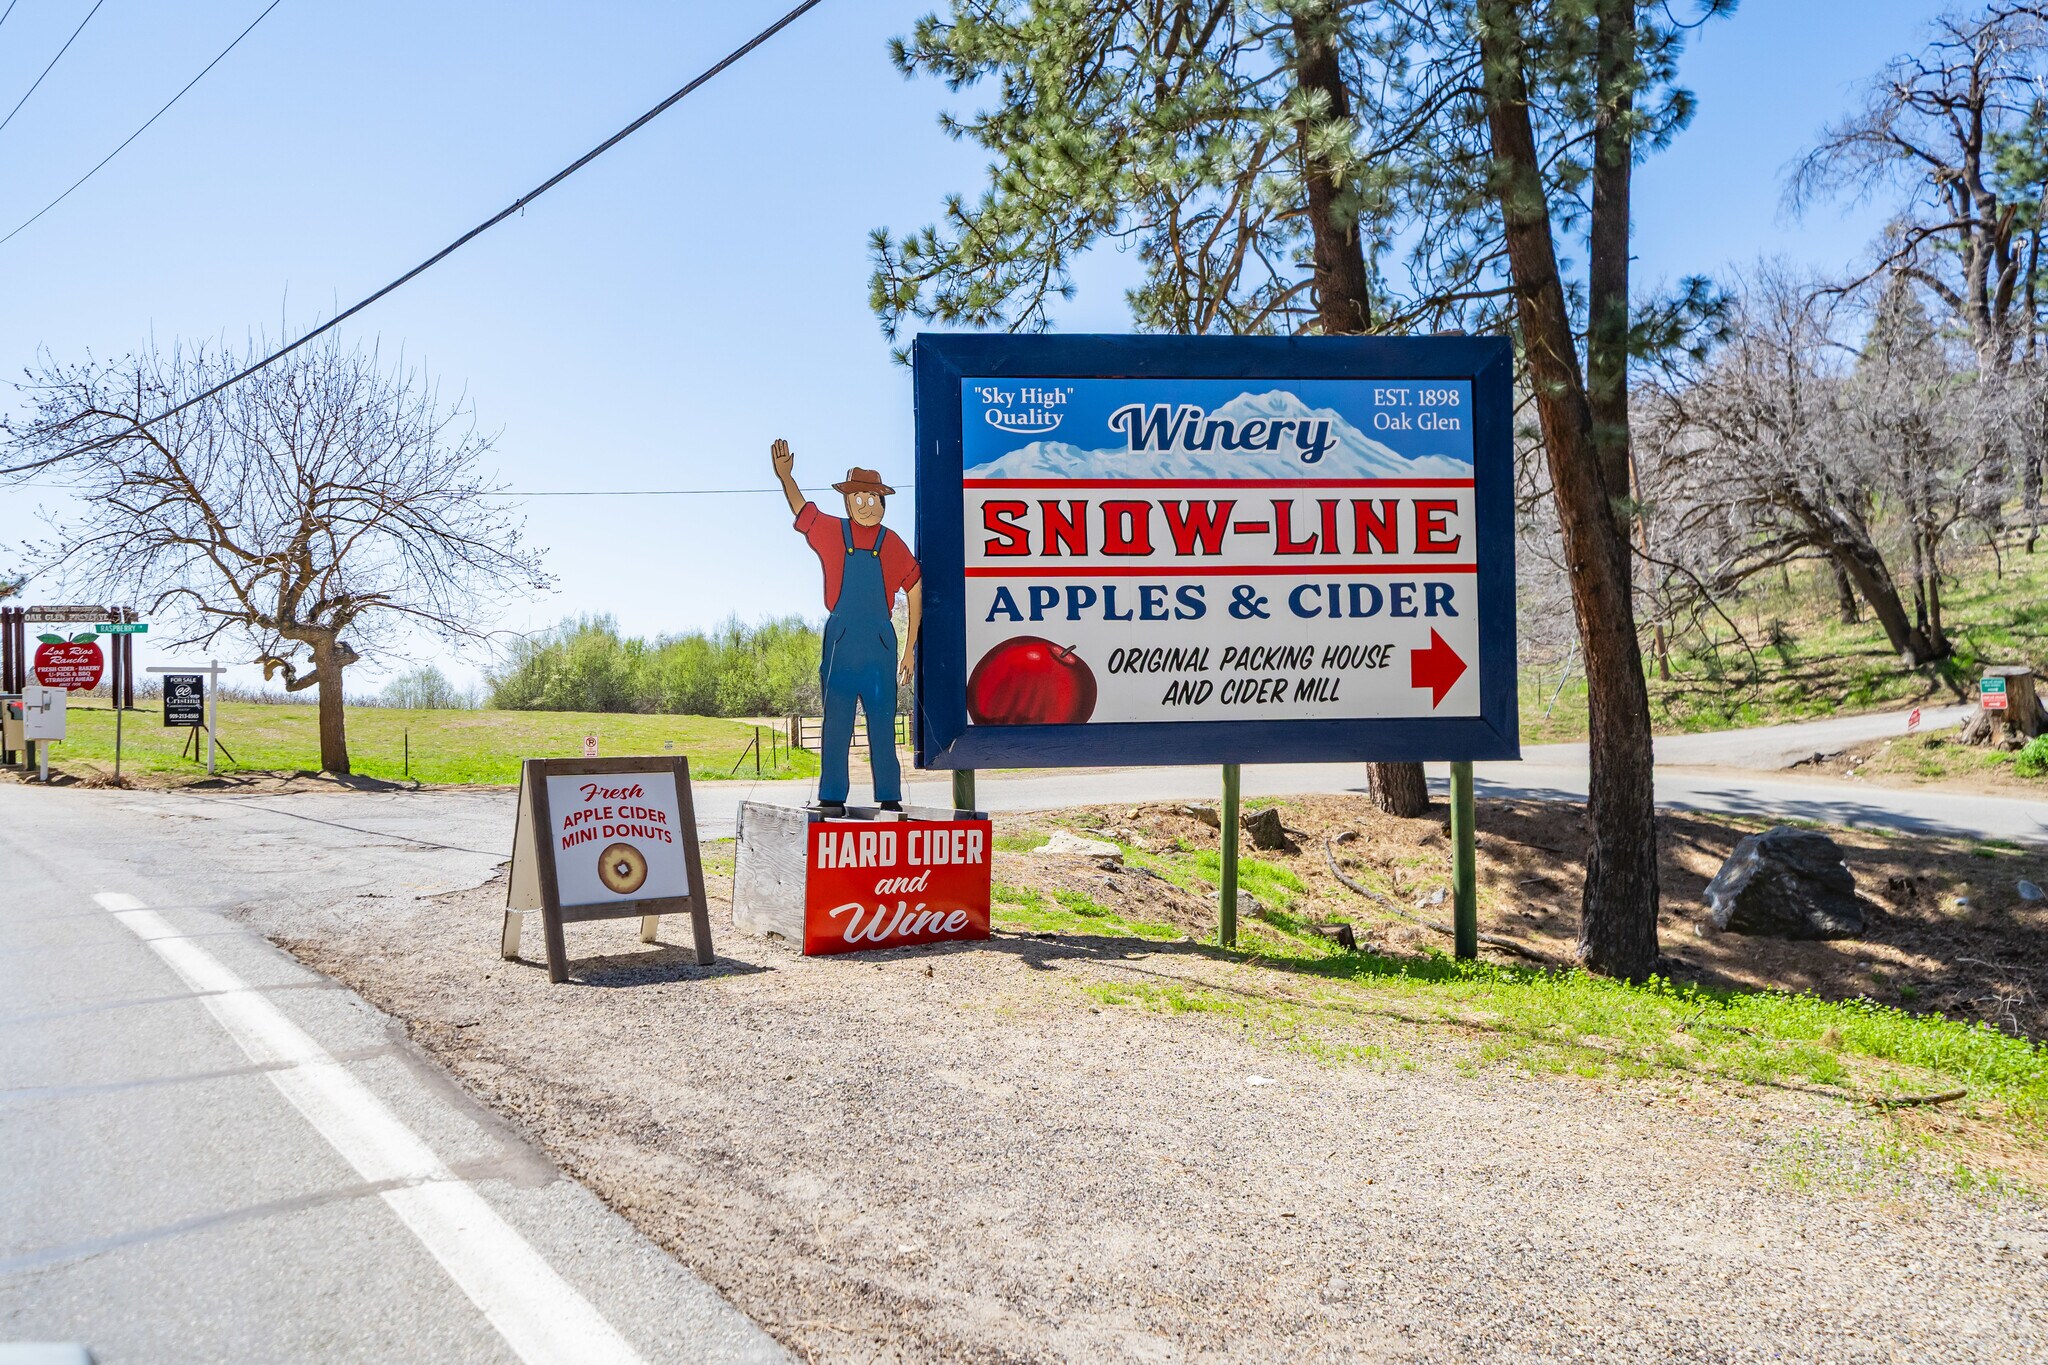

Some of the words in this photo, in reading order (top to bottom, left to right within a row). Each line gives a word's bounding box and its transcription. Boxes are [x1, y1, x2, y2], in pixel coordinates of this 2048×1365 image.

[974, 387, 1015, 408] "Sky
[1021, 387, 1074, 408] High"
[1373, 388, 1413, 407] EST.
[1418, 388, 1460, 407] 1898
[985, 409, 1064, 433] Quality
[1373, 412, 1412, 431] Oak
[1418, 412, 1461, 431] Glen
[1108, 403, 1340, 466] Winery
[980, 499, 1462, 557] SNOW-LINE
[985, 584, 1208, 623] APPLES
[1228, 584, 1271, 620] &
[1288, 582, 1460, 619] CIDER
[24, 613, 41, 621] OAK
[45, 613, 65, 621] GLEN
[42, 646, 65, 655] Los
[69, 646, 93, 655] Rios
[50, 655, 89, 664] Rancho
[1107, 647, 1209, 674] ORIGINAL
[1219, 645, 1315, 671] PACKING
[1321, 644, 1396, 669] HOUSE
[166, 696, 201, 704] Cristina
[1161, 679, 1214, 706] AND
[1220, 678, 1288, 705] CIDER
[1293, 677, 1340, 703] MILL
[580, 783, 645, 802] Fresh
[563, 806, 613, 830] APPLE
[618, 806, 667, 825] CIDER
[562, 826, 597, 850] MINI
[602, 824, 672, 844] DONUTS
[817, 831, 897, 869] HARD
[907, 829, 983, 866] CIDER
[874, 869, 931, 895] and
[829, 900, 969, 943] Wine
